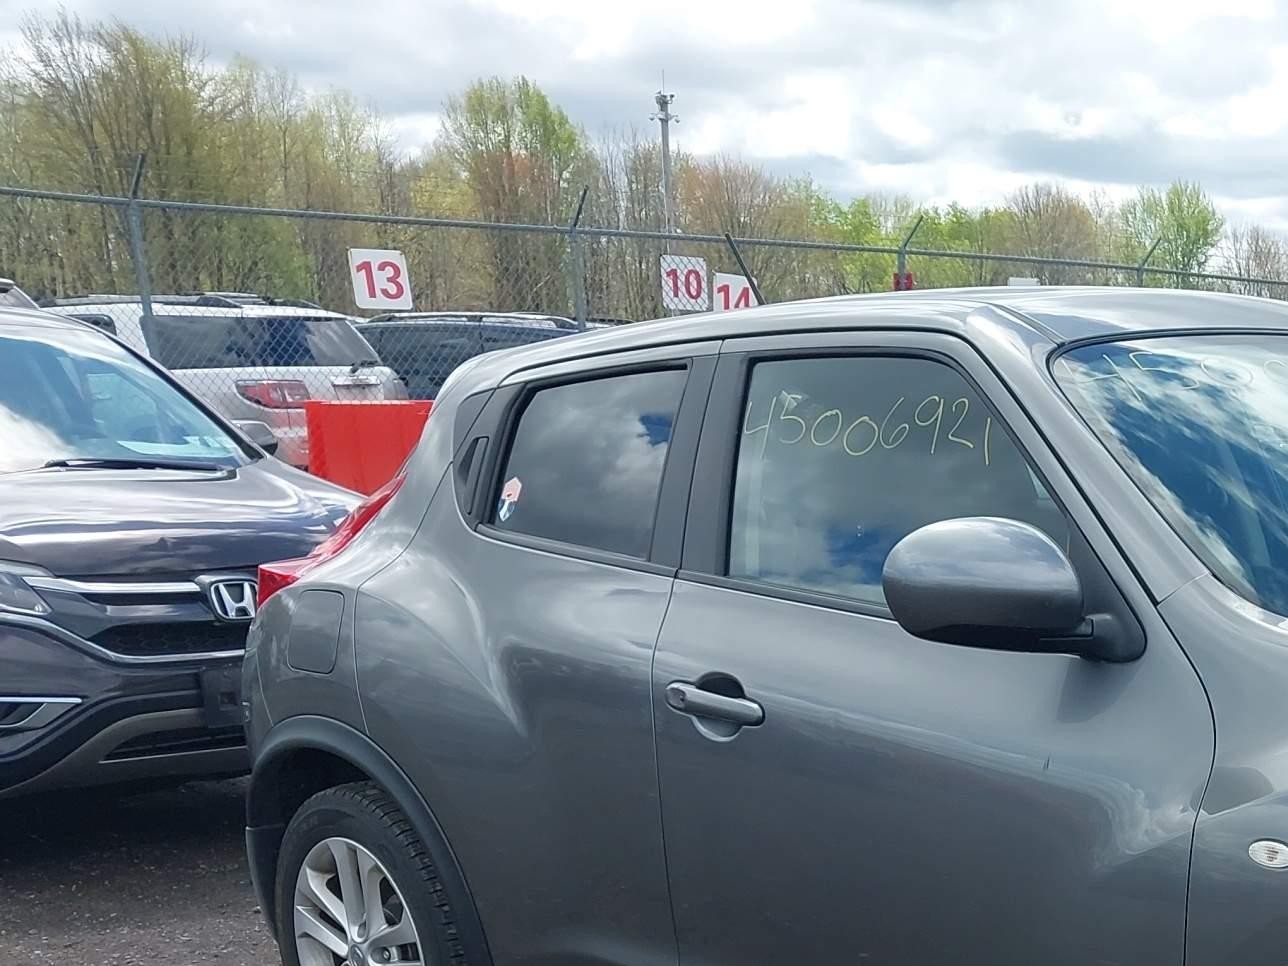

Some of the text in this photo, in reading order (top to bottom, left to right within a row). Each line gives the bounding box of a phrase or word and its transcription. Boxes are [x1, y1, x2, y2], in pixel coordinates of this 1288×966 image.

[355, 260, 405, 300] 13
[665, 268, 702, 300] 10
[744, 390, 992, 467] 45006921
